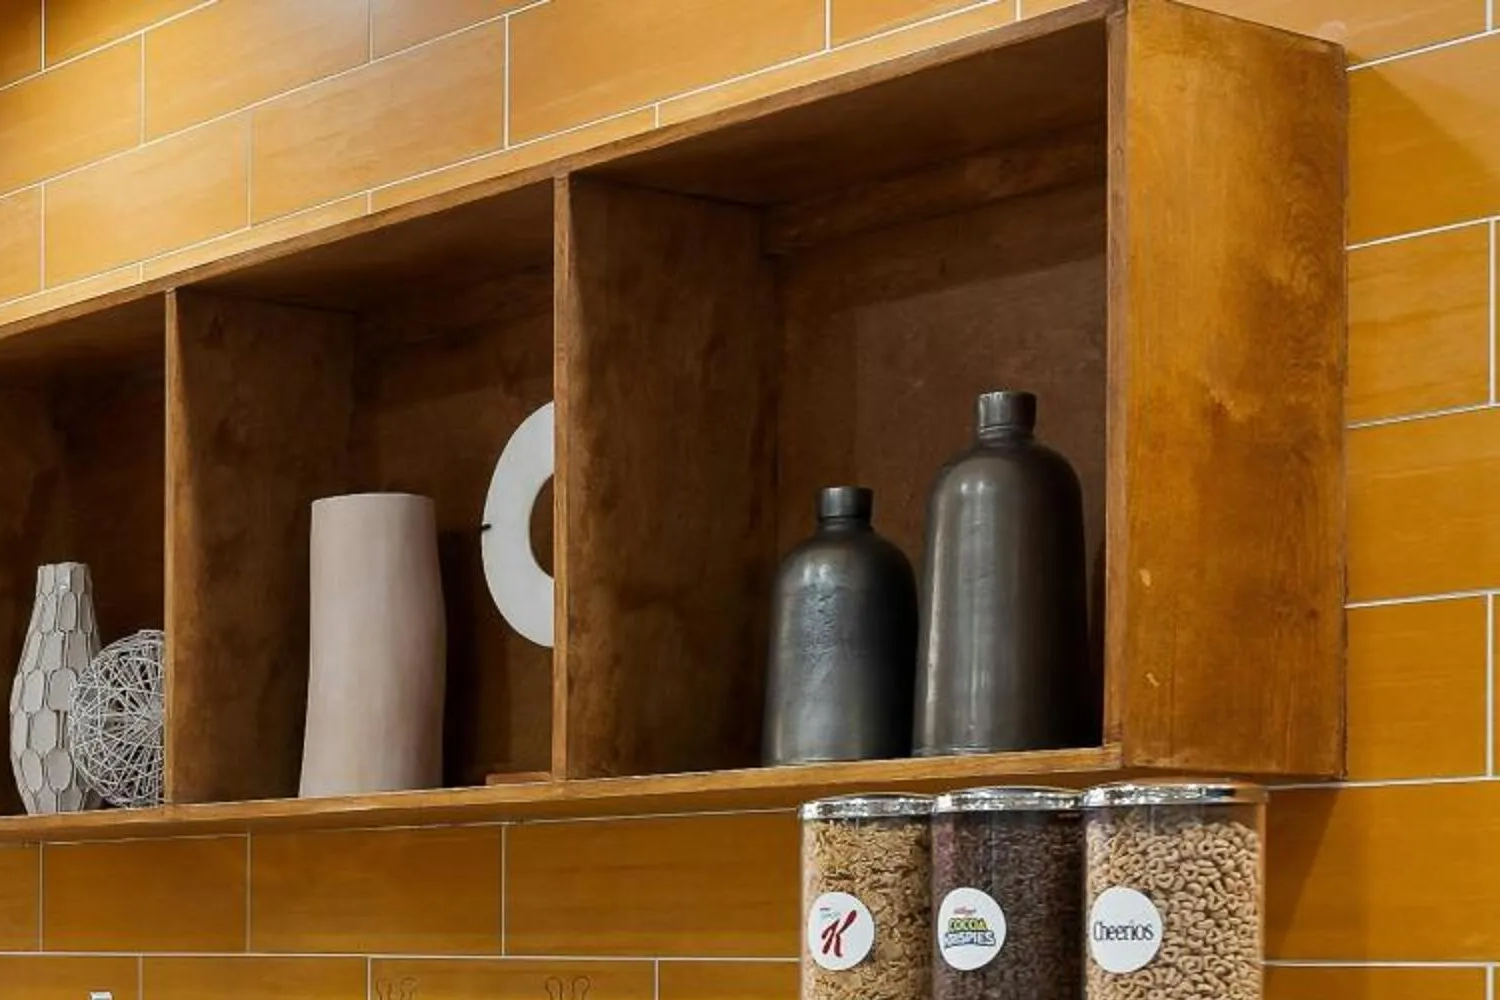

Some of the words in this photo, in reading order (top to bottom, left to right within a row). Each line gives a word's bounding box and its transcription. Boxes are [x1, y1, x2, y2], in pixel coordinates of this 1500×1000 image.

[821, 909, 857, 958] K
[947, 917, 989, 933] COCOA
[1094, 919, 1155, 942] Cheerios
